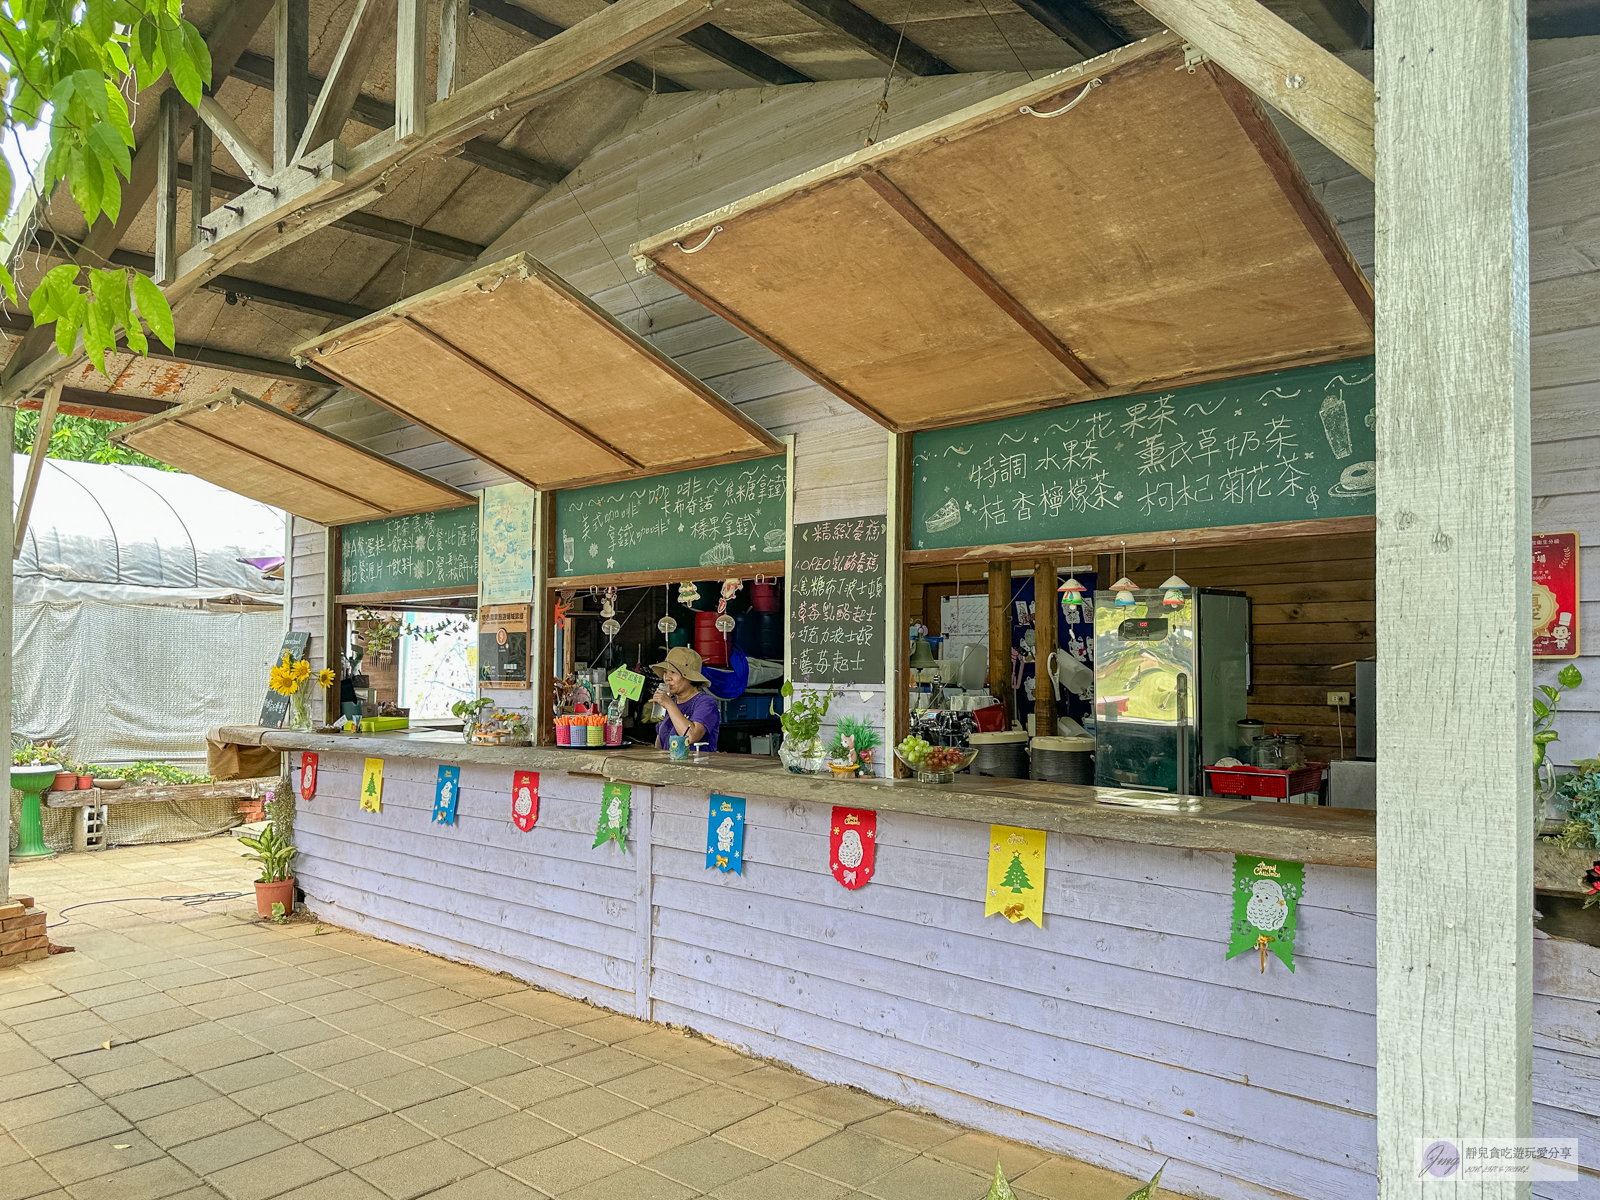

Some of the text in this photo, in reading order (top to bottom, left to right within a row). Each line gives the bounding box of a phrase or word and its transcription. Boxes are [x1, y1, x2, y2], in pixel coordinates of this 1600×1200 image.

[1085, 394, 1178, 440] 花果茶
[648, 475, 702, 504] 咖啡
[661, 494, 714, 518] 卡布奇諾
